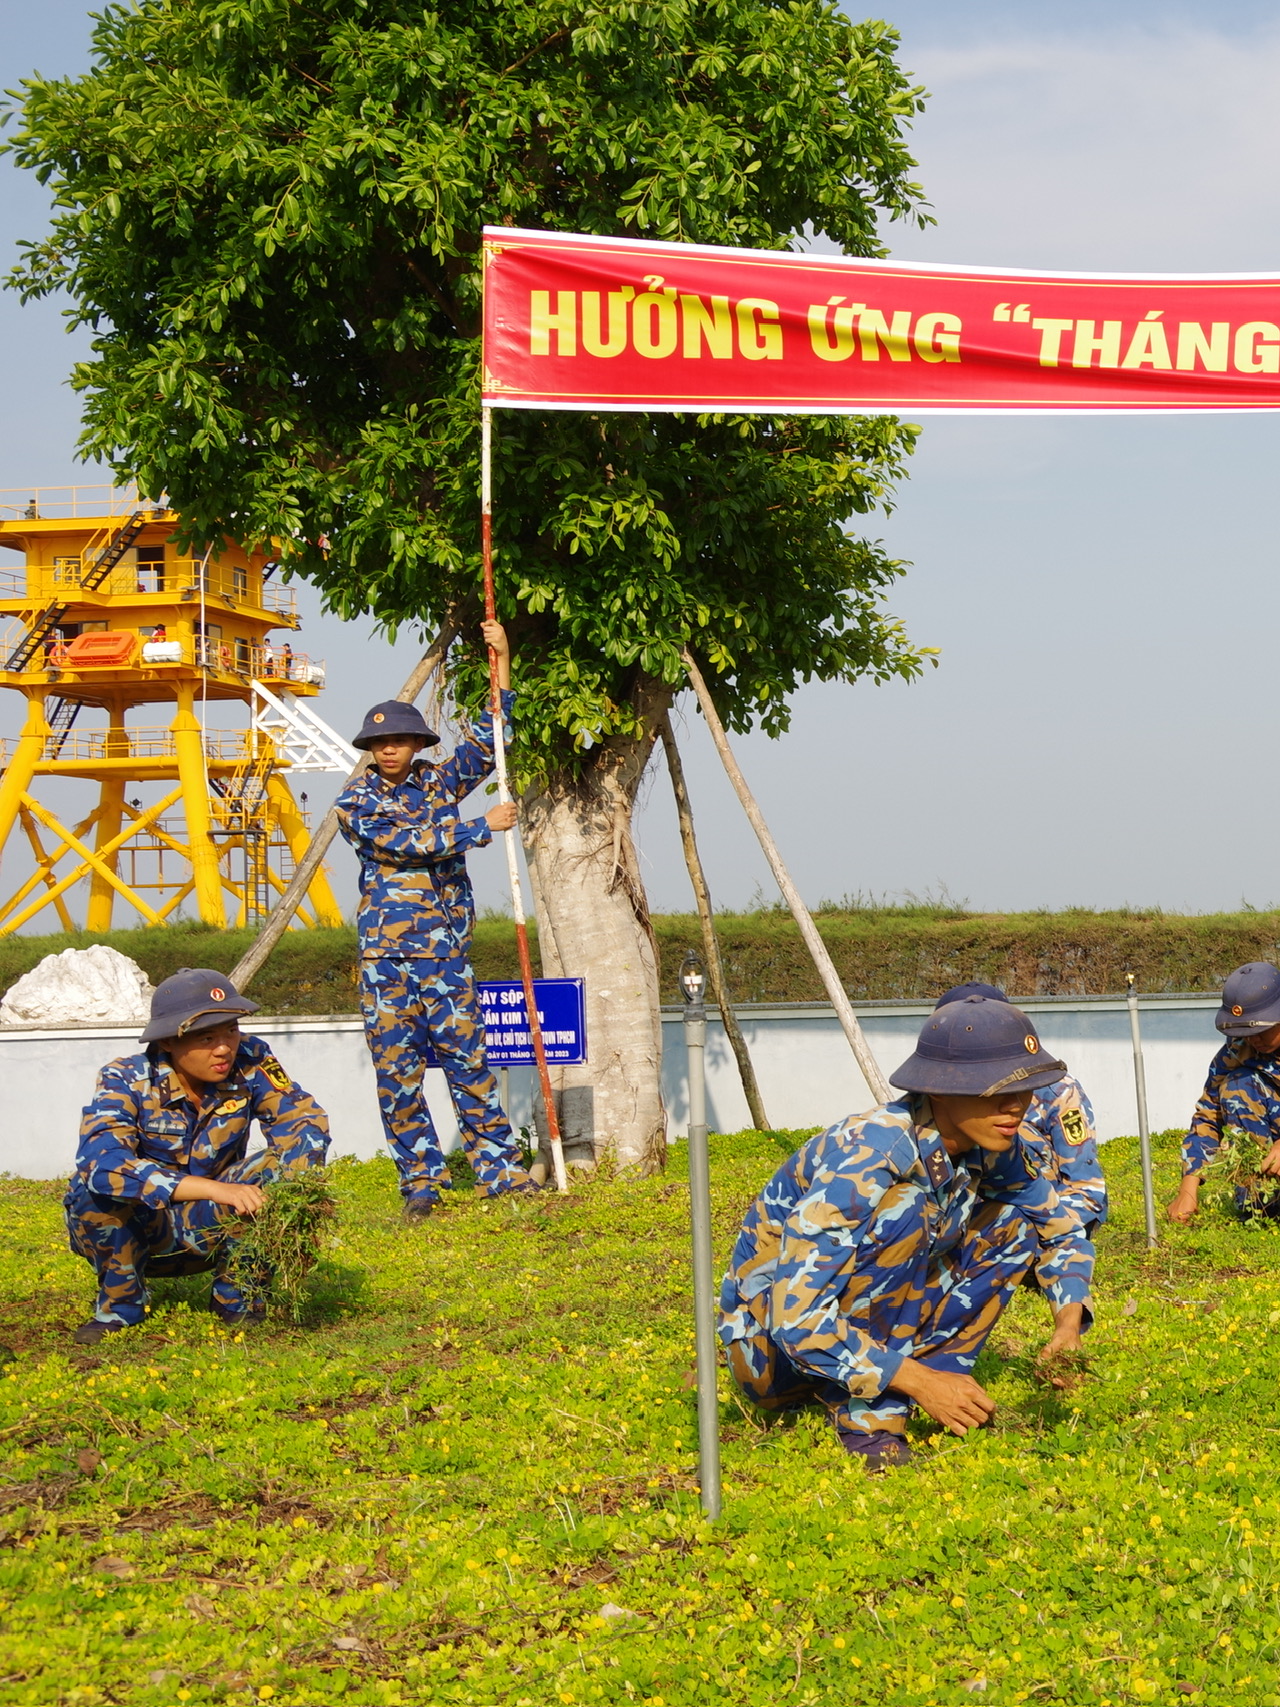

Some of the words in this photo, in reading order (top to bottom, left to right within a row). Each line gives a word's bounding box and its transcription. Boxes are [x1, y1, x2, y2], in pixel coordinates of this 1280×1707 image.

[529, 274, 784, 361] HƯỞNG
[807, 295, 963, 364] ỨNG
[993, 302, 1280, 374] “THÁNG
[500, 989, 525, 1007] SỘP
[501, 1011, 522, 1025] KIM
[523, 1011, 544, 1024] YN
